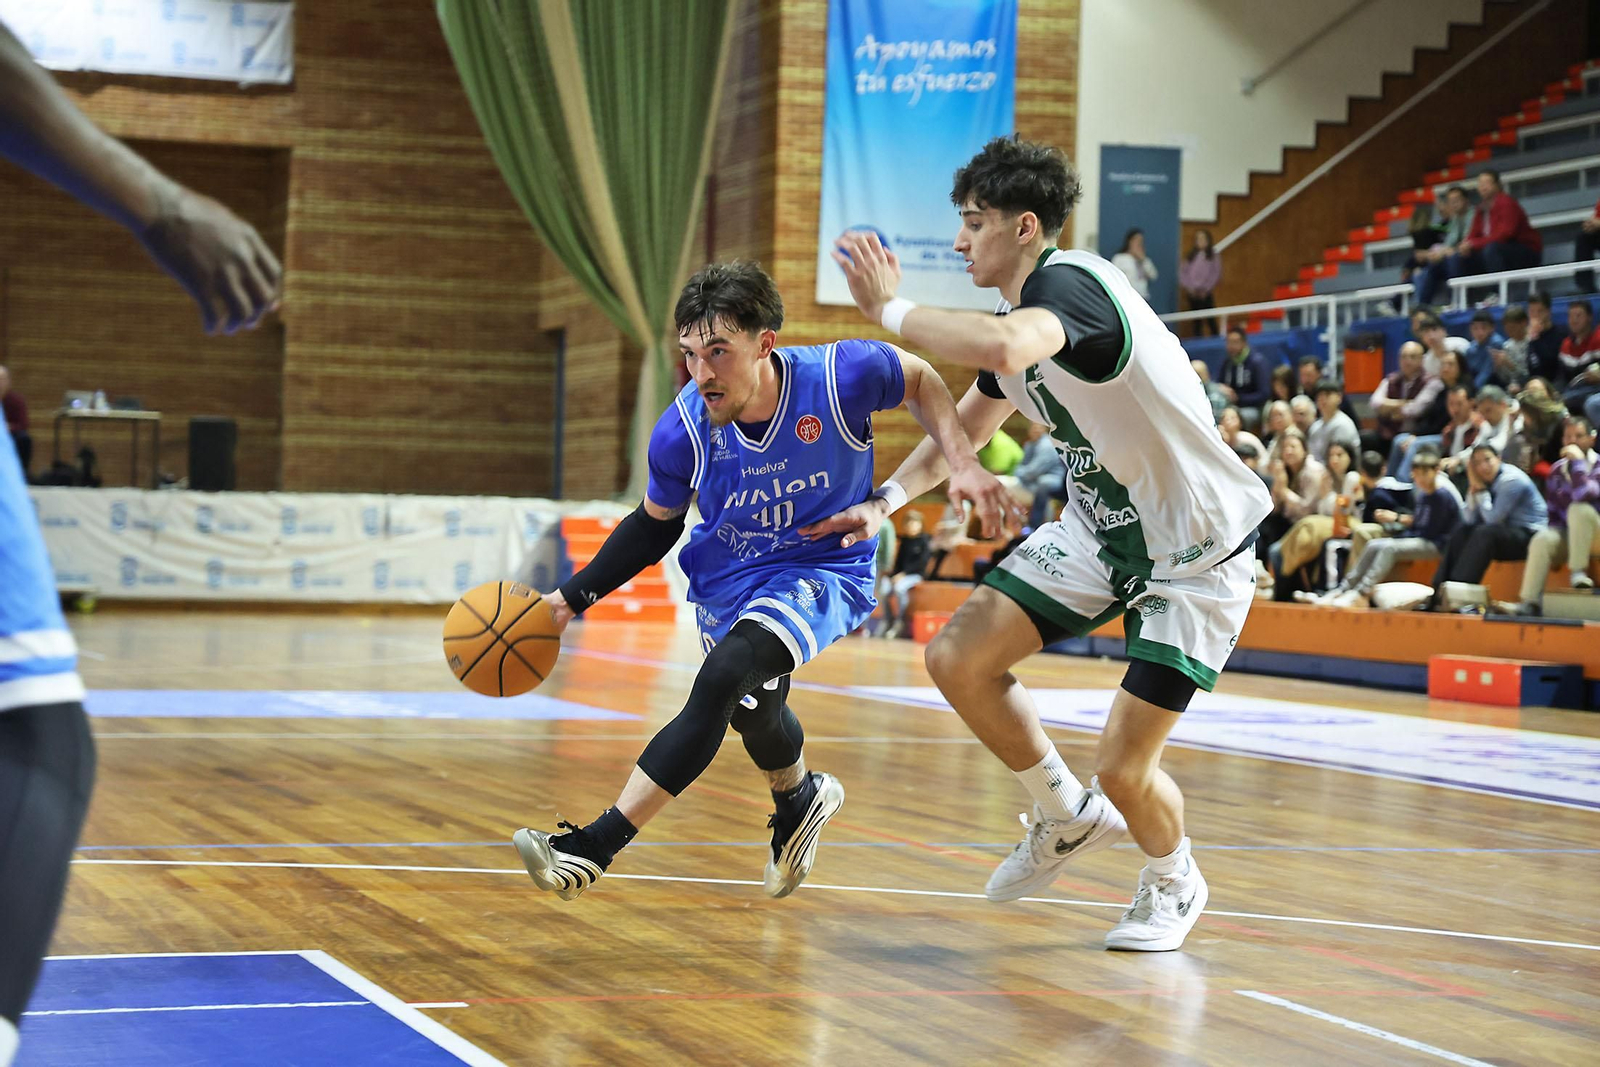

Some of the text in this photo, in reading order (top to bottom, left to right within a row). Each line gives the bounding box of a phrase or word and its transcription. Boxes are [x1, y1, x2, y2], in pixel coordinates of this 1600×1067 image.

[854, 34, 997, 74] Apoyamos
[855, 64, 997, 107] tu esfuerzo
[741, 460, 787, 479] Huelva
